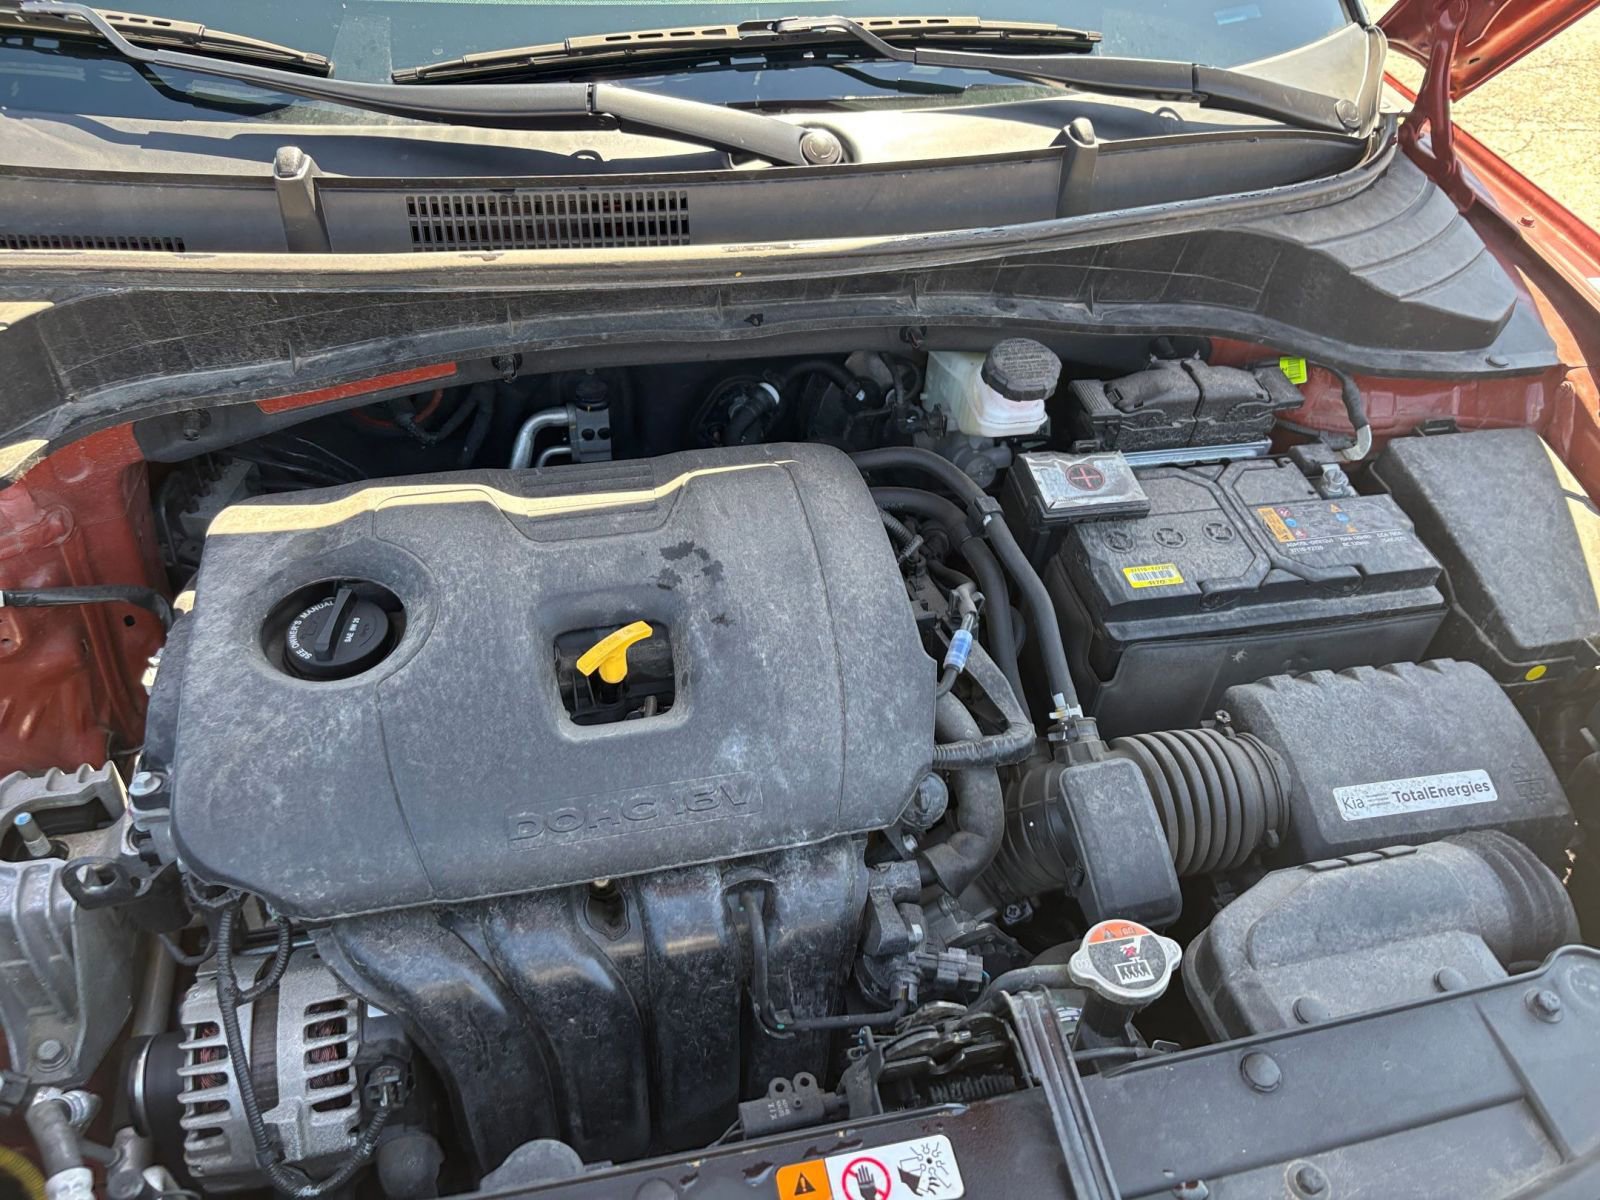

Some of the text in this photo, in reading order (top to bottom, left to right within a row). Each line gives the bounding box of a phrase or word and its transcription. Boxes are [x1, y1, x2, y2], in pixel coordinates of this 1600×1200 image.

[288, 600, 335, 660] SEE OWNER'S MANUAL
[508, 780, 754, 842] DOHC 16V
[1343, 797, 1365, 811] Kia
[1392, 780, 1490, 804] TotalEnergies
